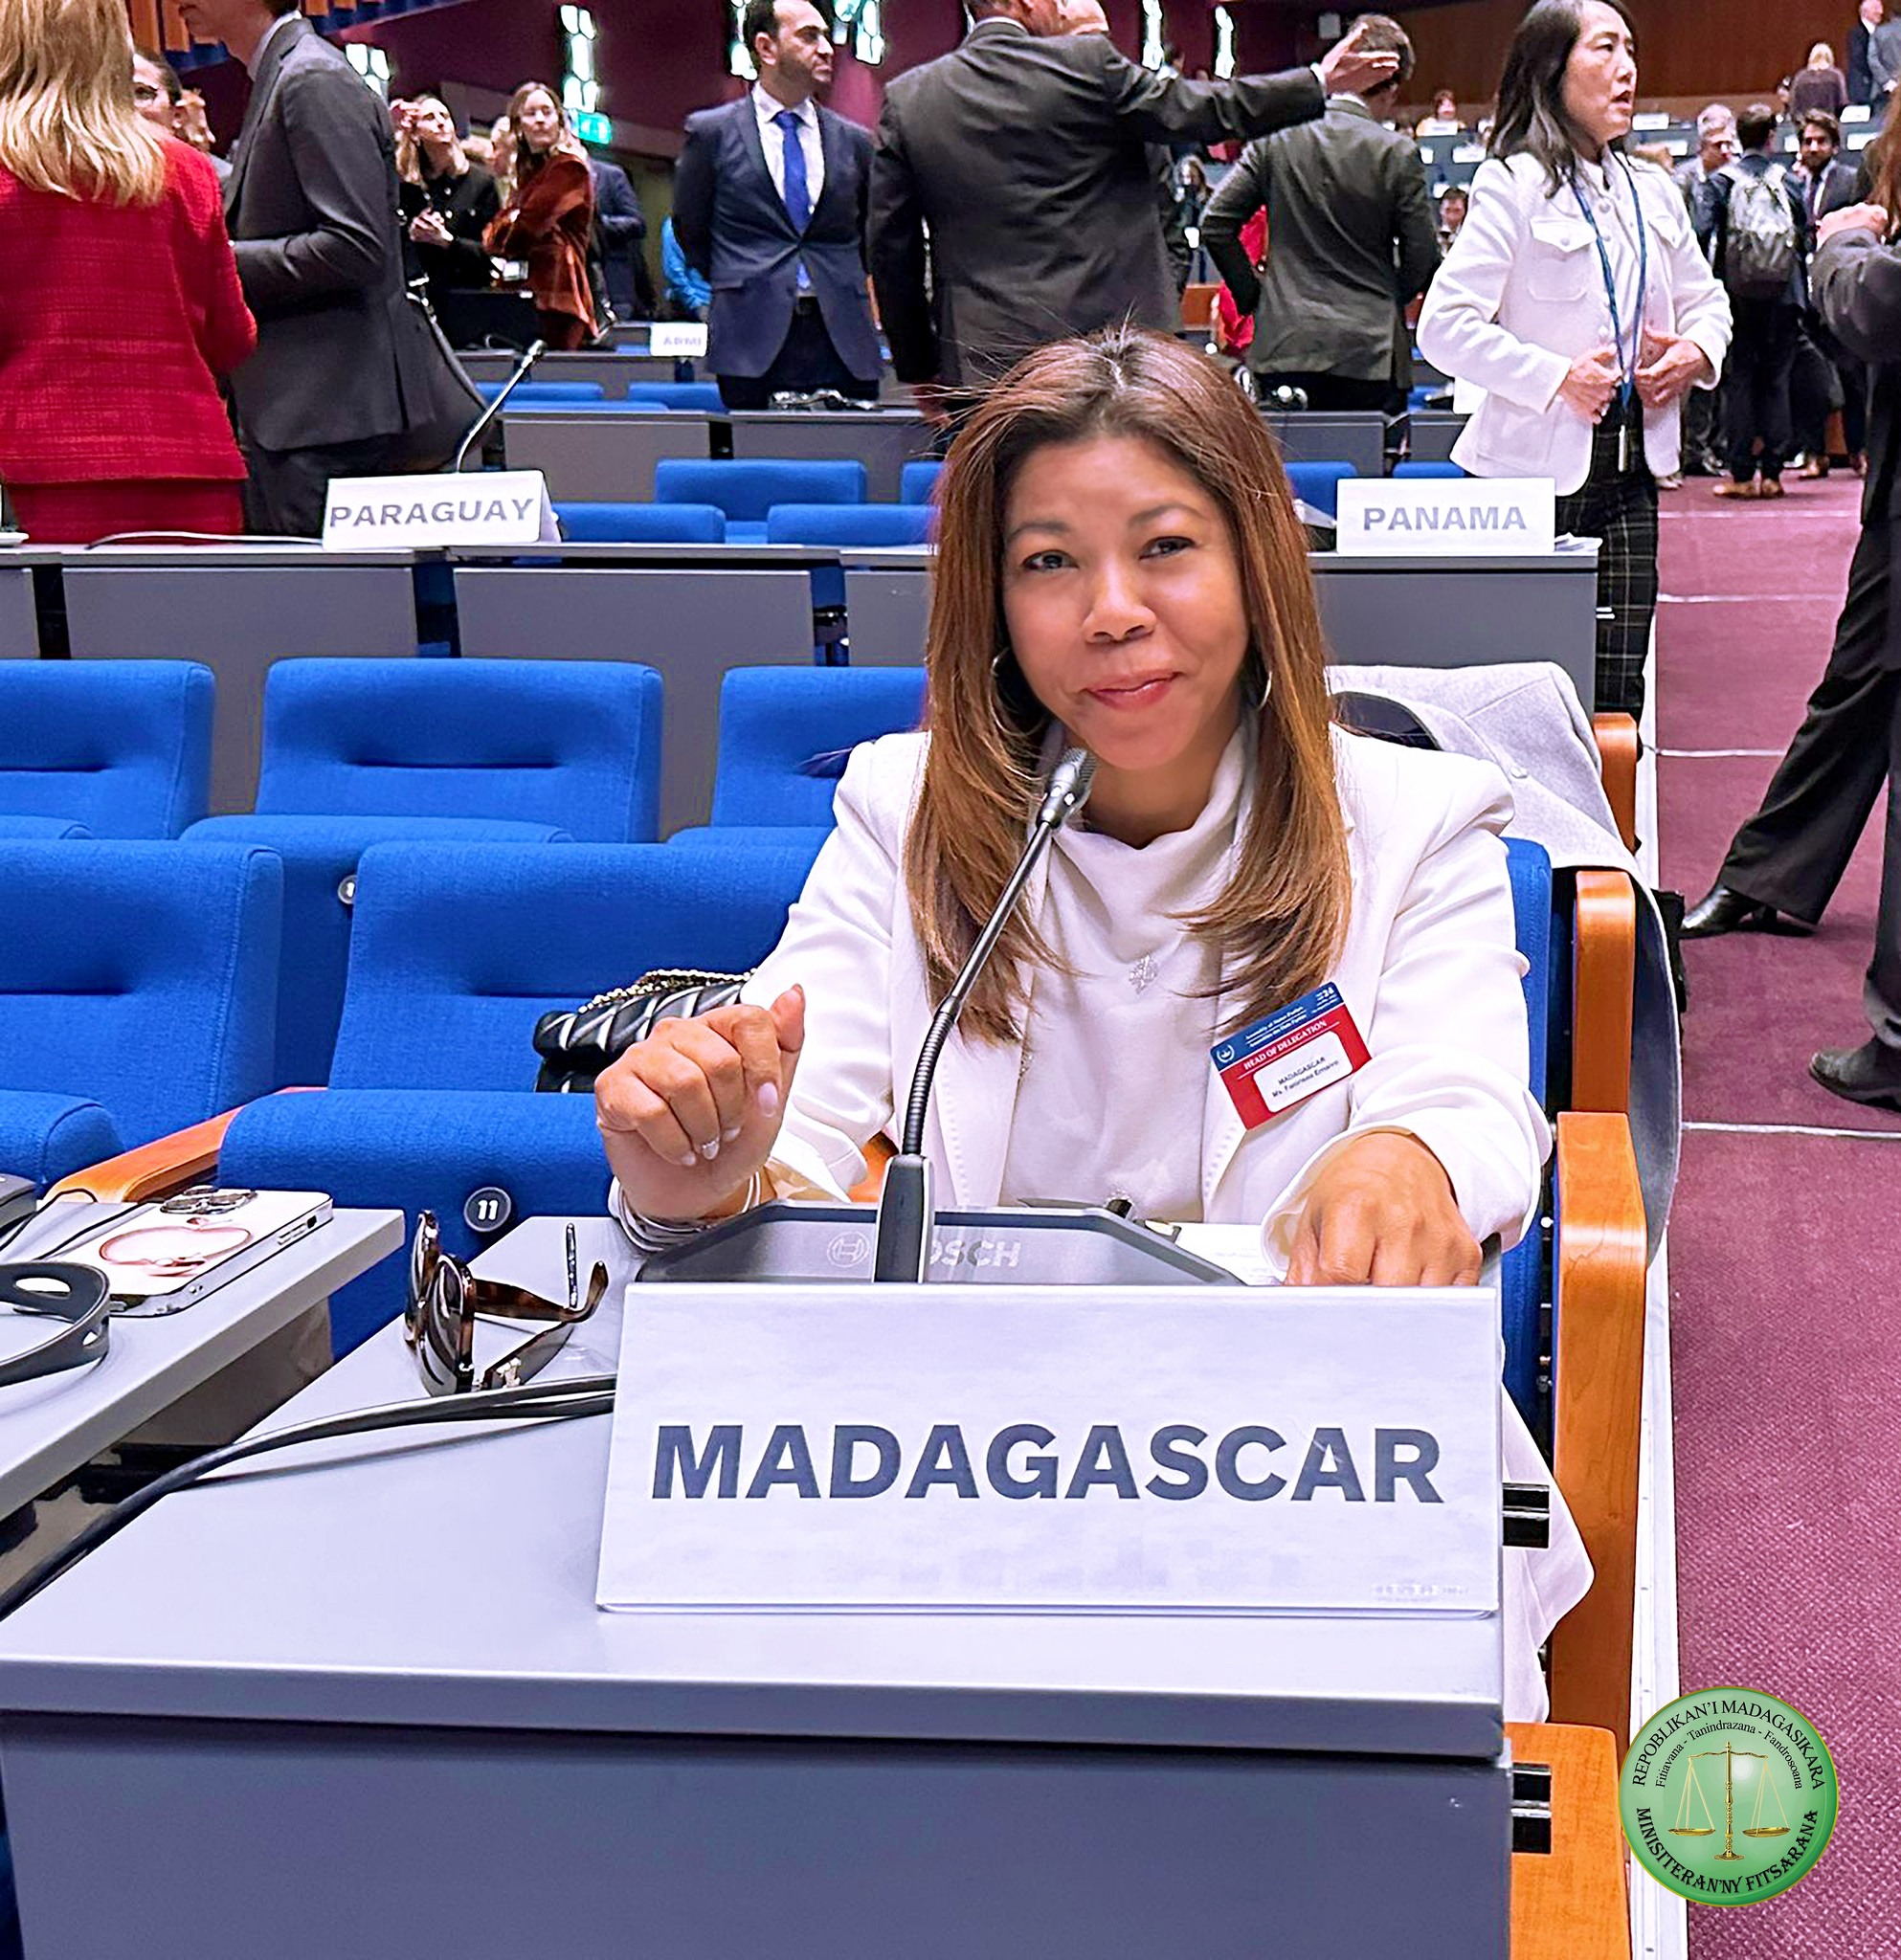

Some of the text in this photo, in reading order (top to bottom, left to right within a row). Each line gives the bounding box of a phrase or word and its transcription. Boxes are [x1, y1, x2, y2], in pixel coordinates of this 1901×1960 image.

[329, 498, 534, 527] PARAGUAY
[1363, 506, 1528, 531] PANAMA
[1243, 1054, 1267, 1071] HEAD
[1265, 1045, 1279, 1058] OF
[1277, 1019, 1328, 1052] DELEGATION
[478, 1199, 499, 1220] 11
[930, 1239, 1021, 1268] SCH
[652, 1423, 1444, 1503] MADAGASCAR
